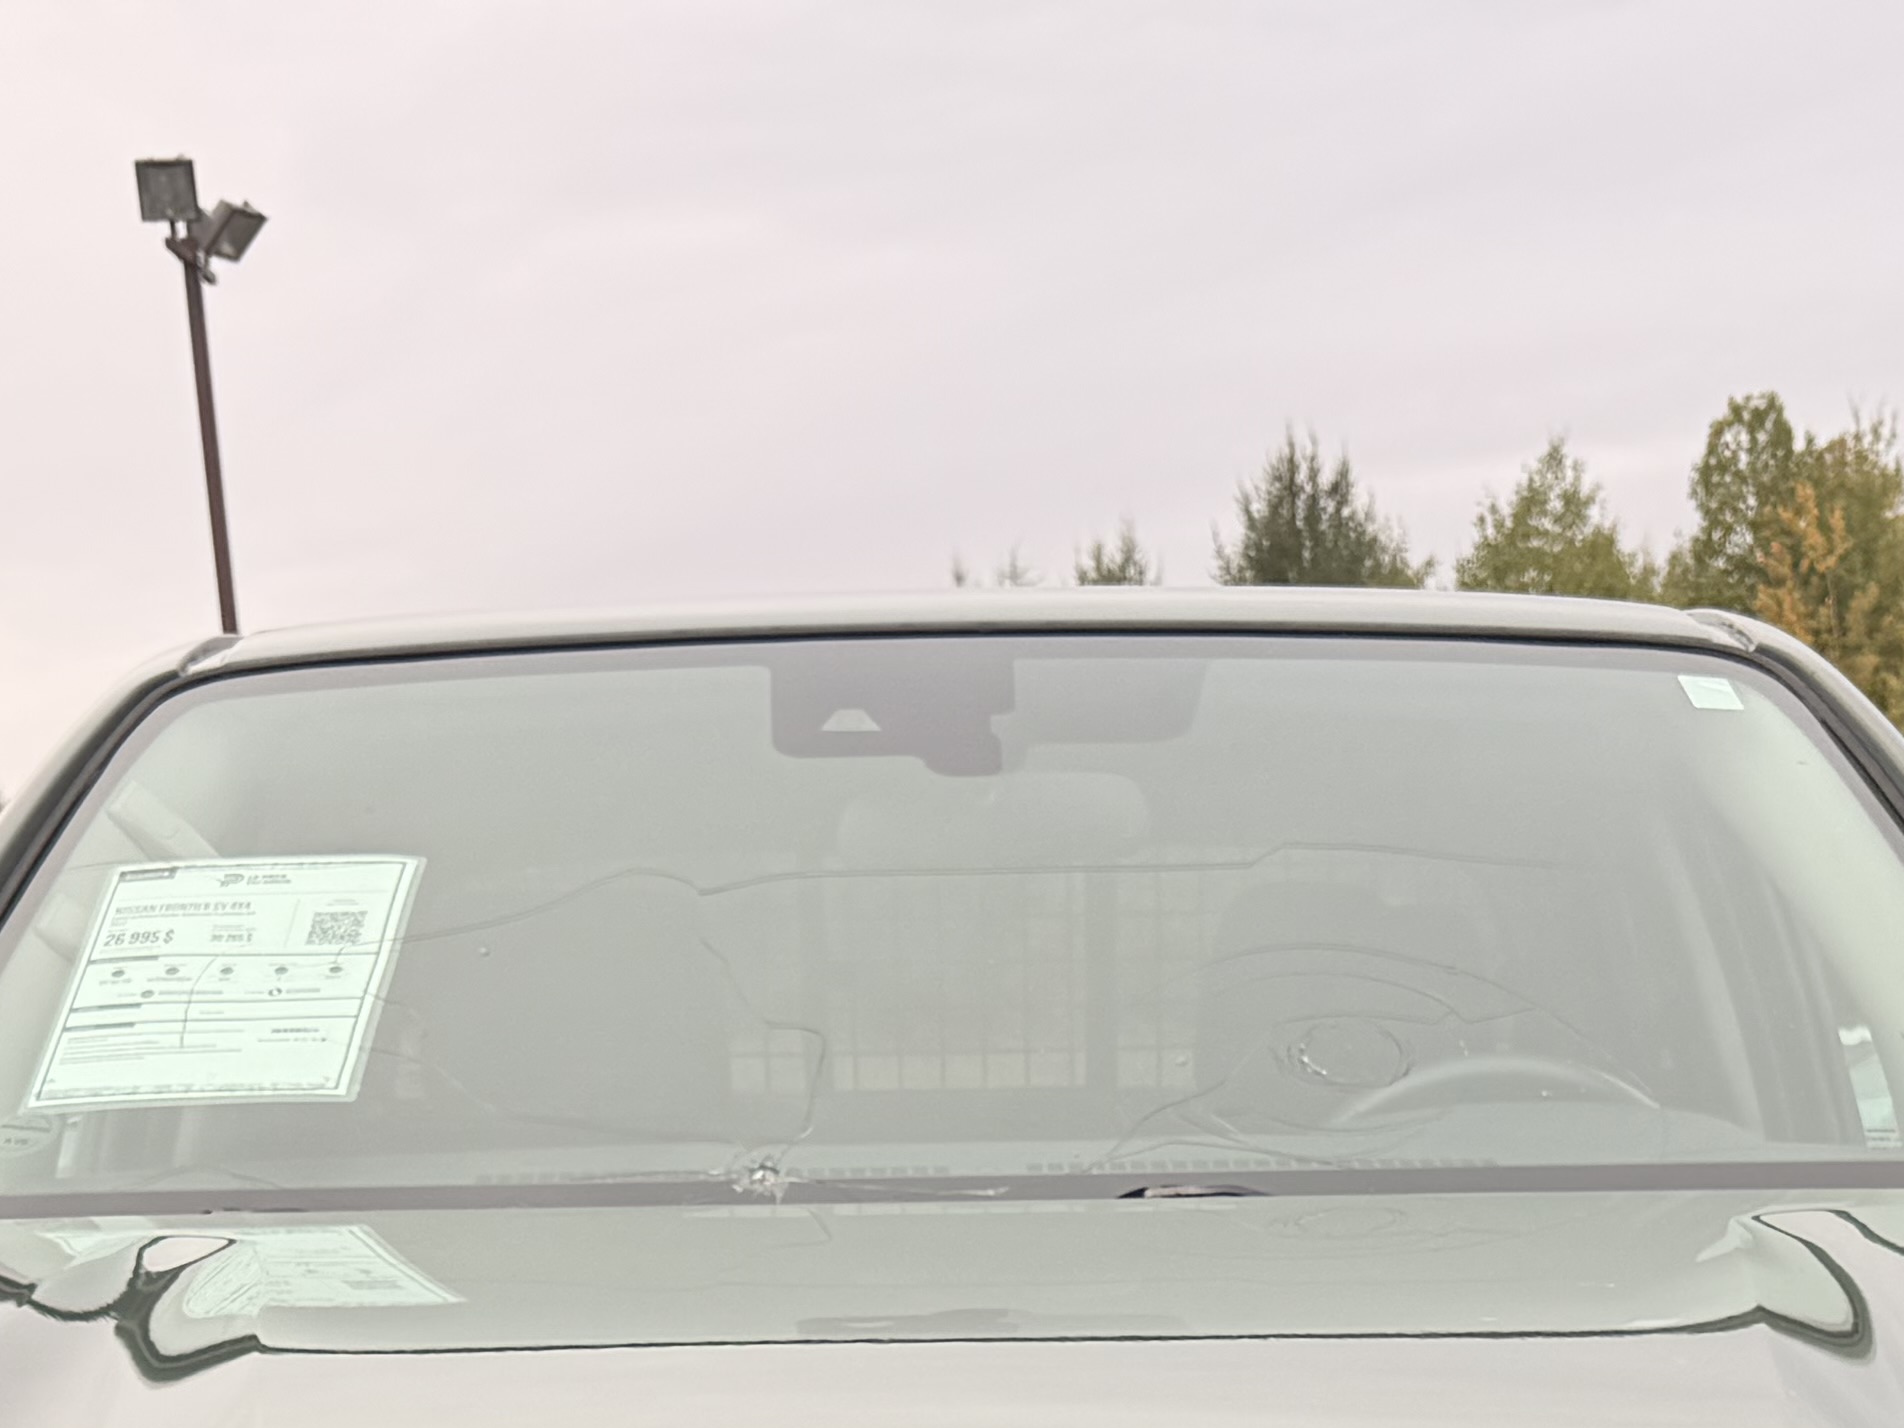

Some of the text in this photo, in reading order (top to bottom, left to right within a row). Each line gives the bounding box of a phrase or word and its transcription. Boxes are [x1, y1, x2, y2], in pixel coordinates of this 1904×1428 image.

[103, 929, 175, 947] 26 995 $
